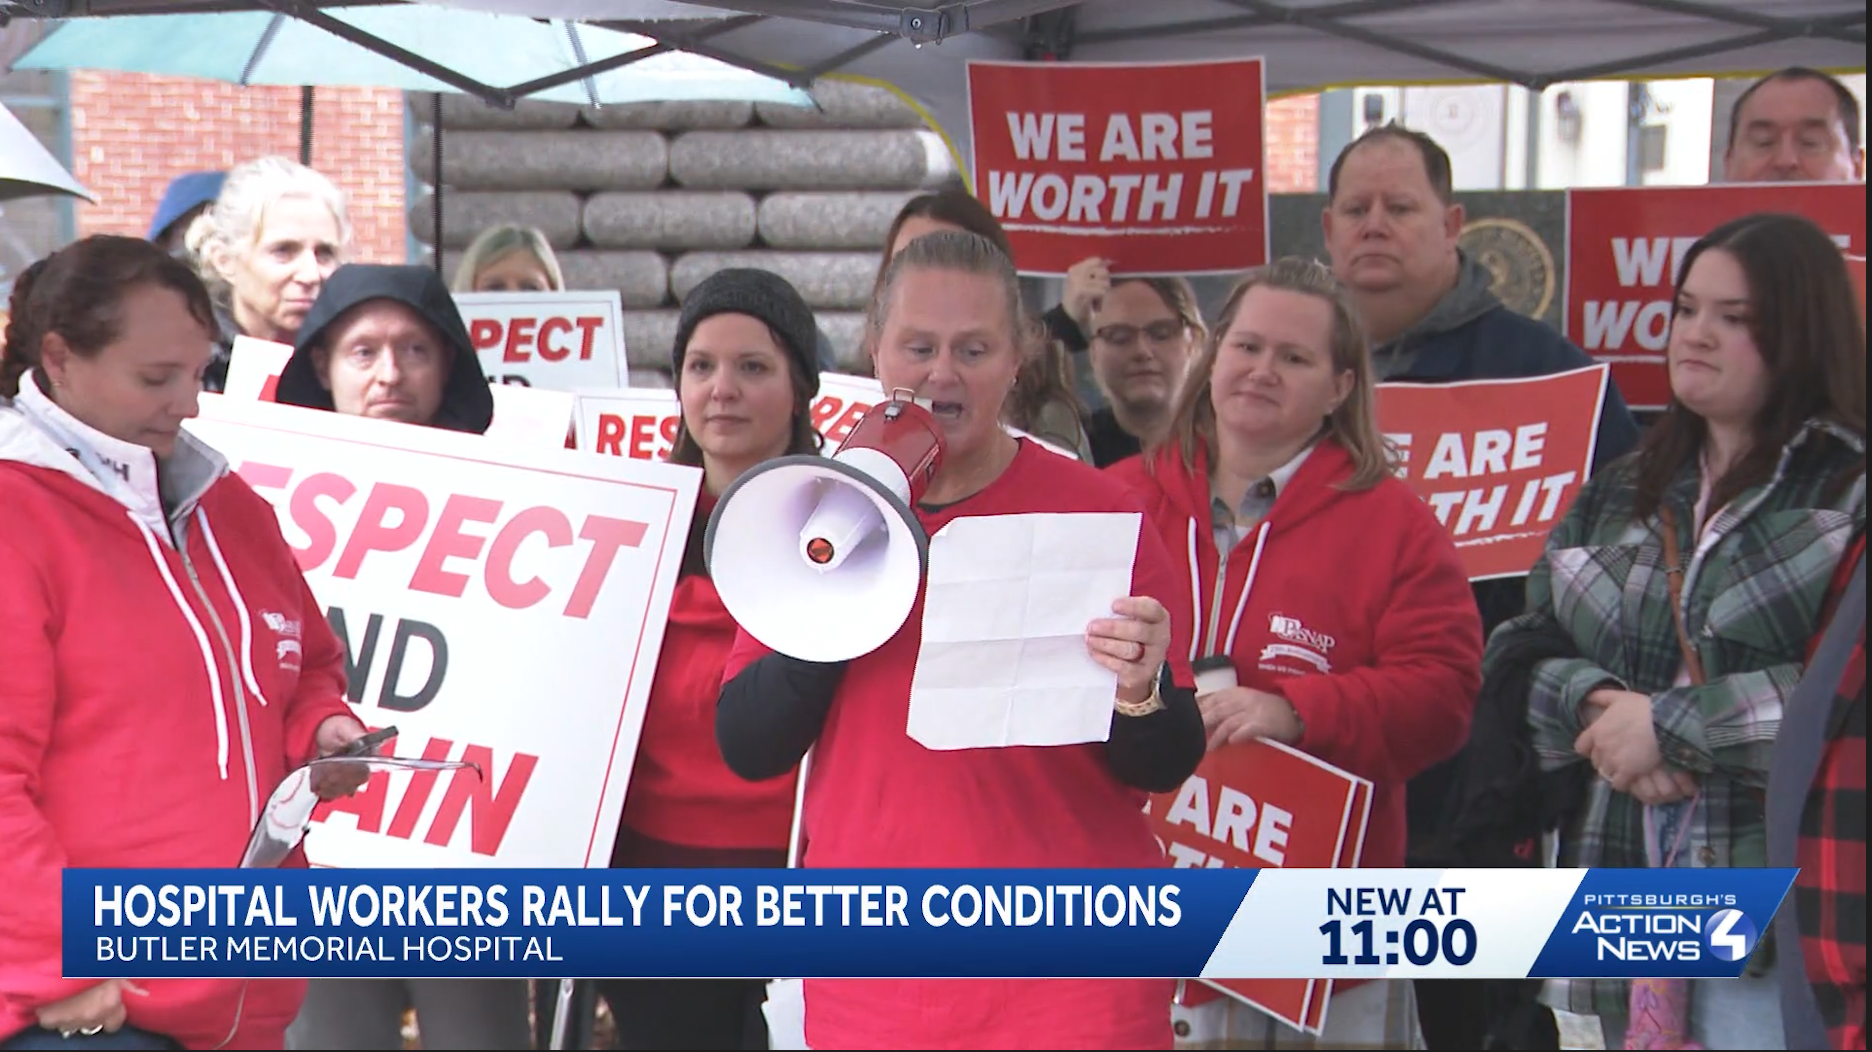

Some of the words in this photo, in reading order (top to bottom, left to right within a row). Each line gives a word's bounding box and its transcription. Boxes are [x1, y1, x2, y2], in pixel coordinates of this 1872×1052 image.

[1007, 112, 1085, 161] WE
[1100, 110, 1213, 161] ARE
[988, 170, 1183, 222] WORTH
[1195, 169, 1253, 218] IT
[1423, 421, 1548, 480] ARE
[1510, 471, 1577, 526] IT
[1165, 774, 1293, 868] ARE
